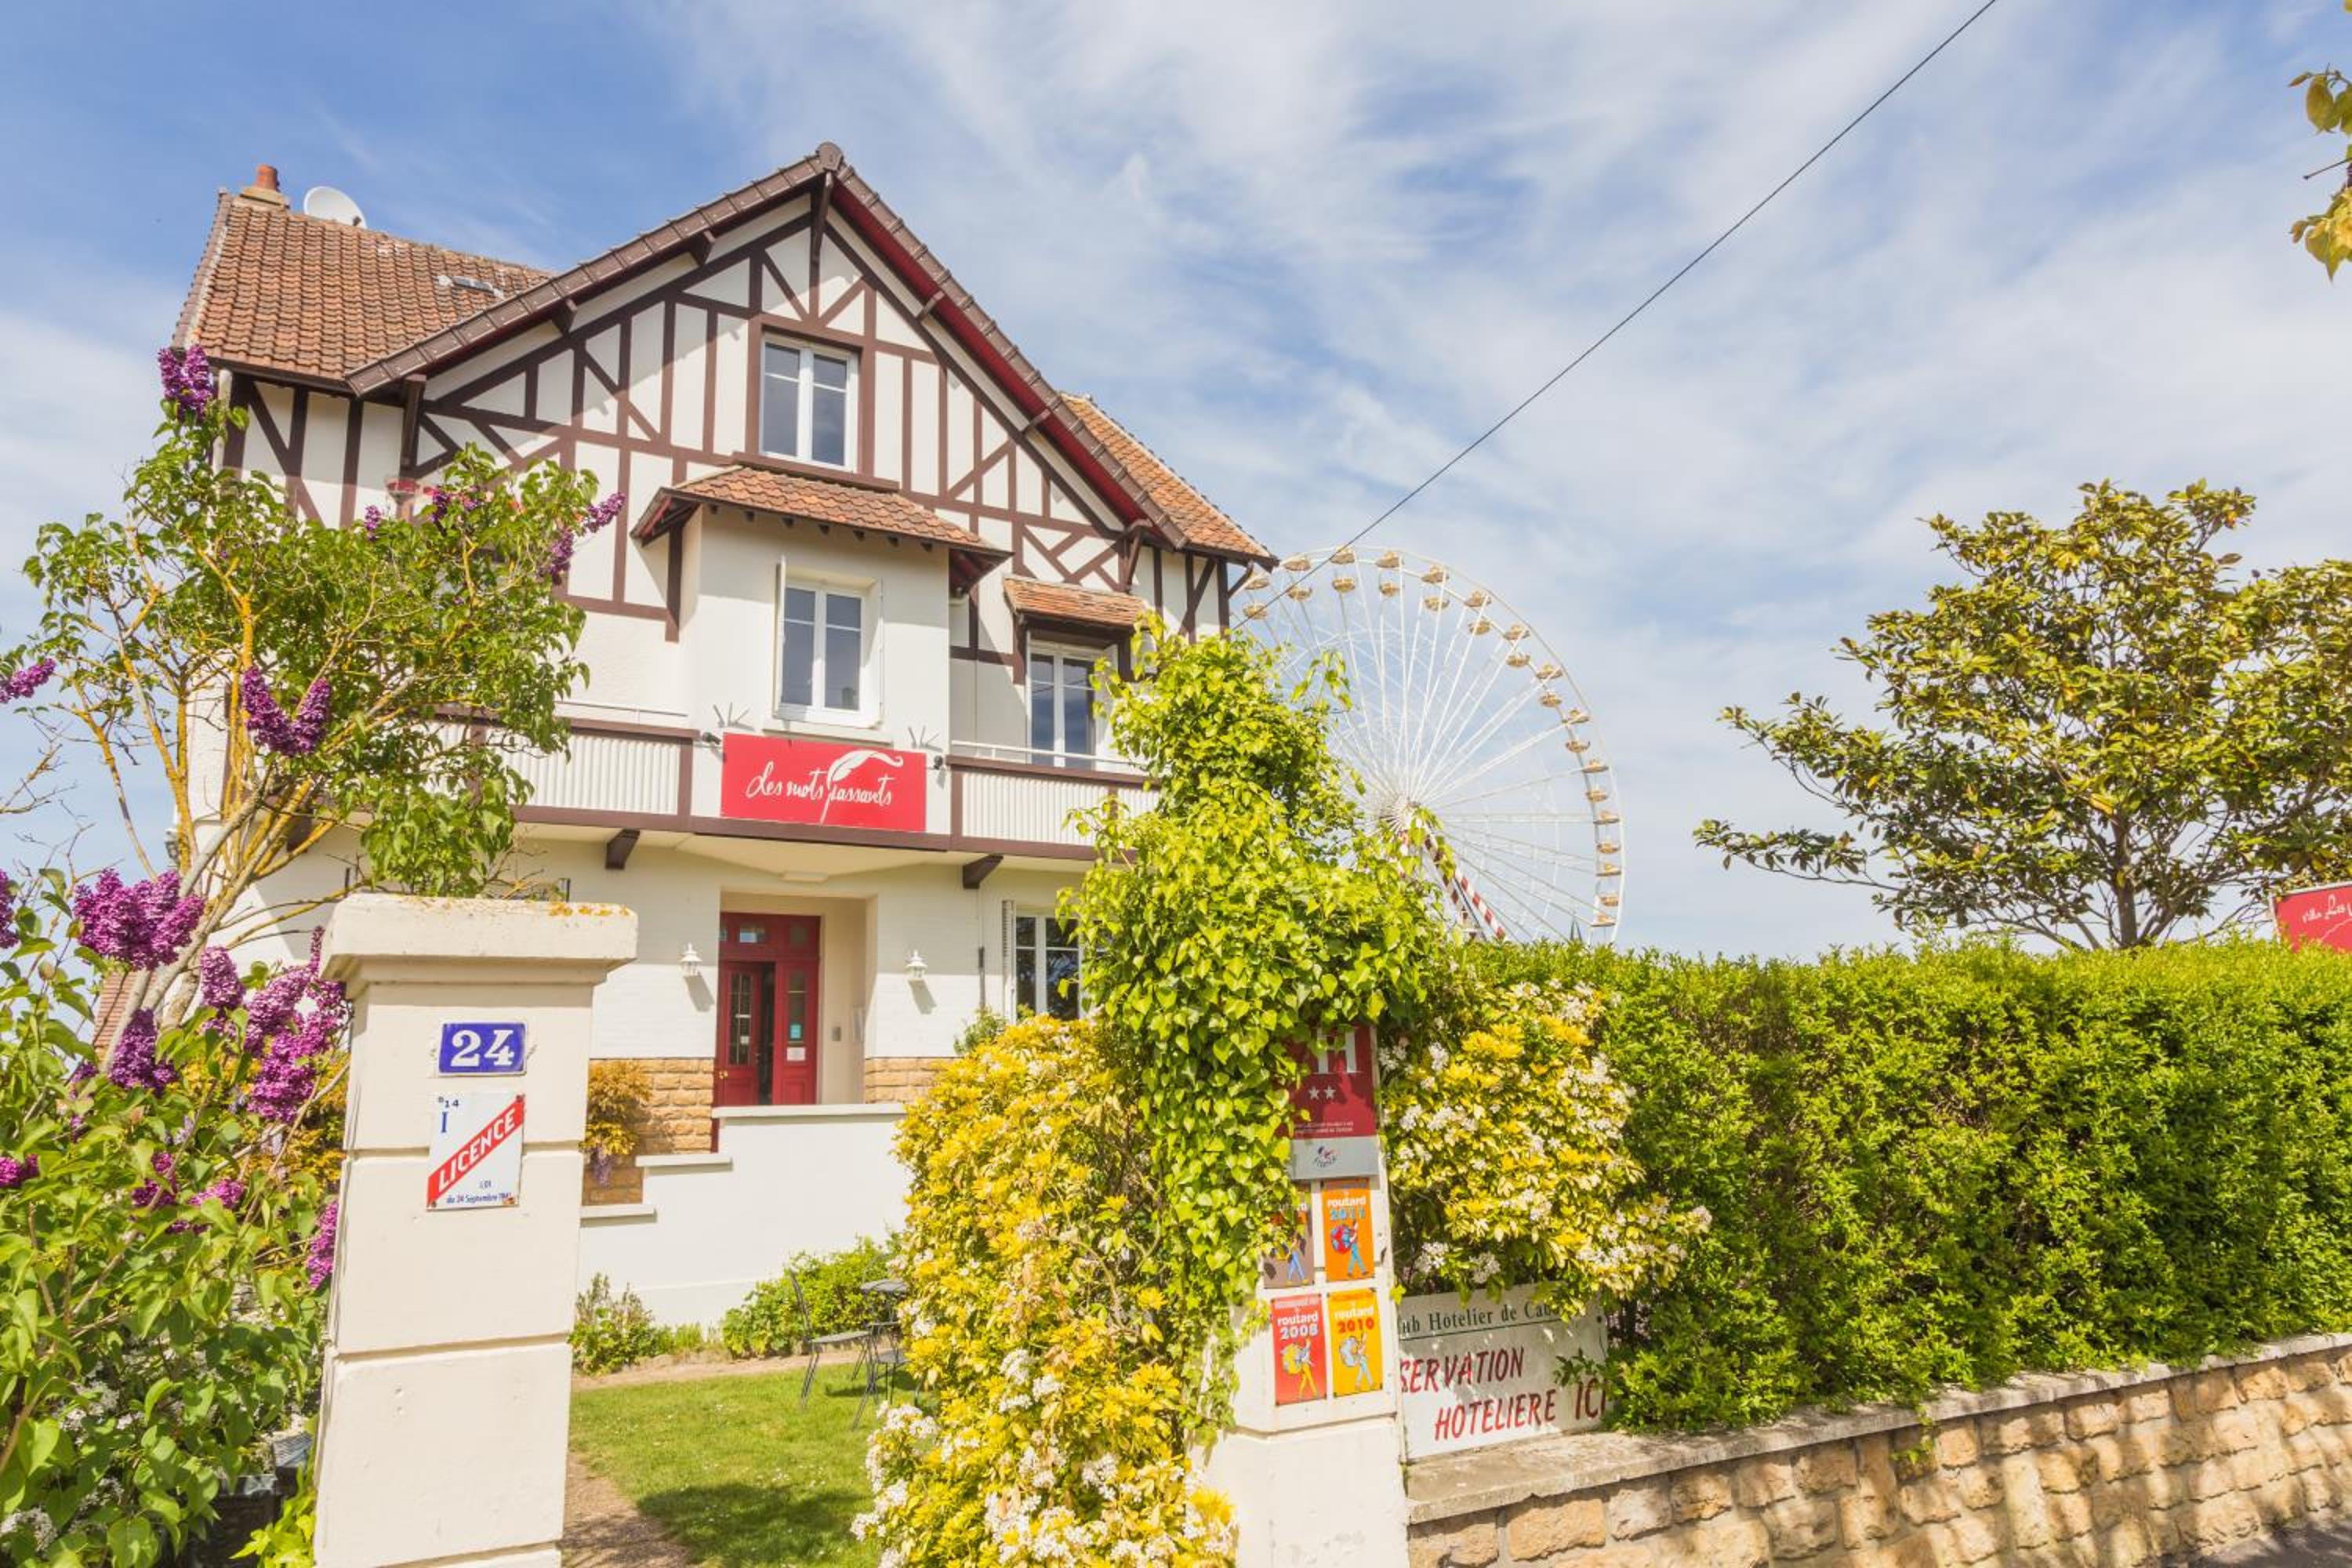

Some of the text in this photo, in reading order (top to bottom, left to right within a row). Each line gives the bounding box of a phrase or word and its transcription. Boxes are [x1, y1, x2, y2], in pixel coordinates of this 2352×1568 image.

[787, 768, 827, 800] mots
[451, 1029, 514, 1066] 24
[438, 1108, 516, 1192] LICENCE
[1328, 1196, 1367, 1208] routard
[1330, 1207, 1366, 1221] 2011
[1277, 1311, 1319, 1327] routard
[1334, 1305, 1374, 1319] routard
[1429, 1308, 1494, 1331] Hotelier
[1501, 1304, 1517, 1323] de
[1280, 1323, 1319, 1340] 2008
[1338, 1317, 1374, 1334] 2010
[1435, 1389, 1557, 1441] HOTELIERE
